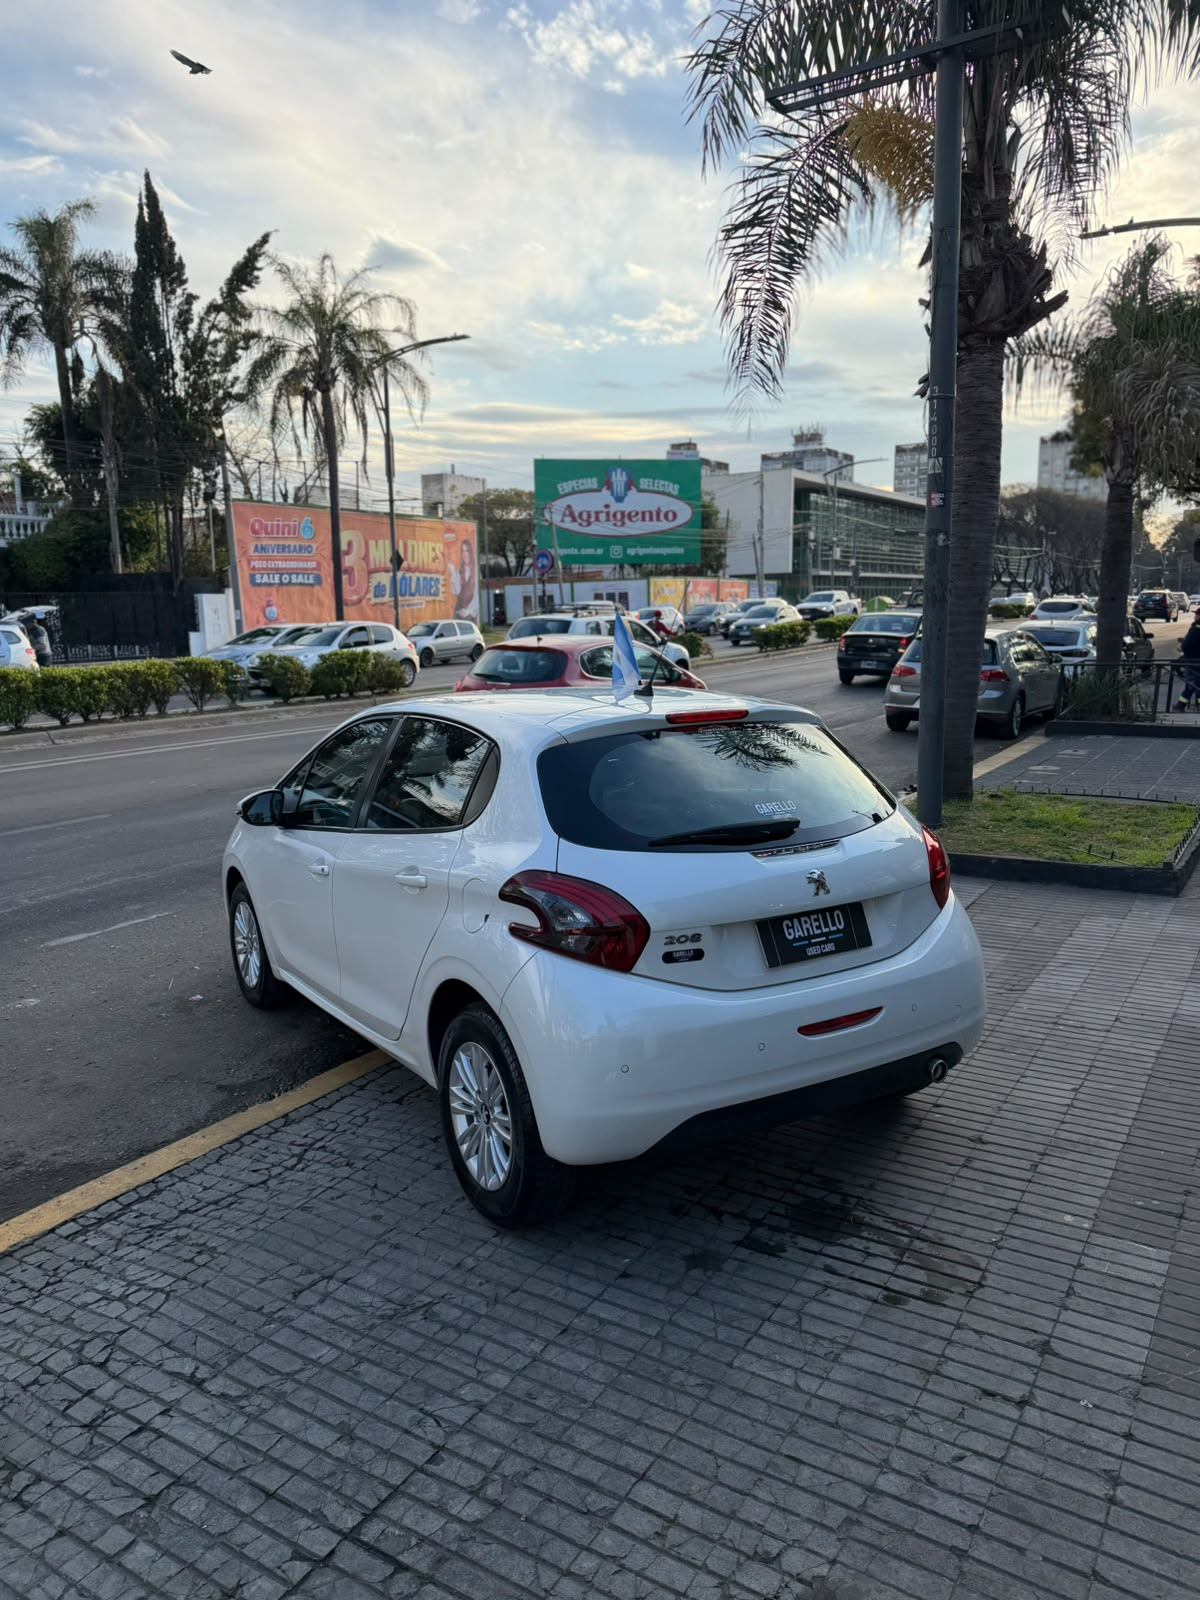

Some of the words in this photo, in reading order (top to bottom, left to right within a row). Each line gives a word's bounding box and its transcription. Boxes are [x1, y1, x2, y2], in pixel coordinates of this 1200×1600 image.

[556, 478, 599, 495] ESPECIAS
[639, 478, 680, 495] SELECTAS
[560, 503, 678, 528] Agrigento
[249, 517, 299, 538] Quini
[300, 516, 316, 540] 6
[253, 543, 314, 554] ANIVERSARIO
[340, 530, 368, 605] 3
[255, 573, 280, 584] SALE
[281, 573, 290, 584] O
[291, 573, 315, 584] SALE
[373, 582, 387, 599] de
[755, 800, 797, 814] GARELLO
[783, 910, 845, 940] GARELLO
[664, 933, 702, 946] 208
[806, 946, 821, 956] USED
